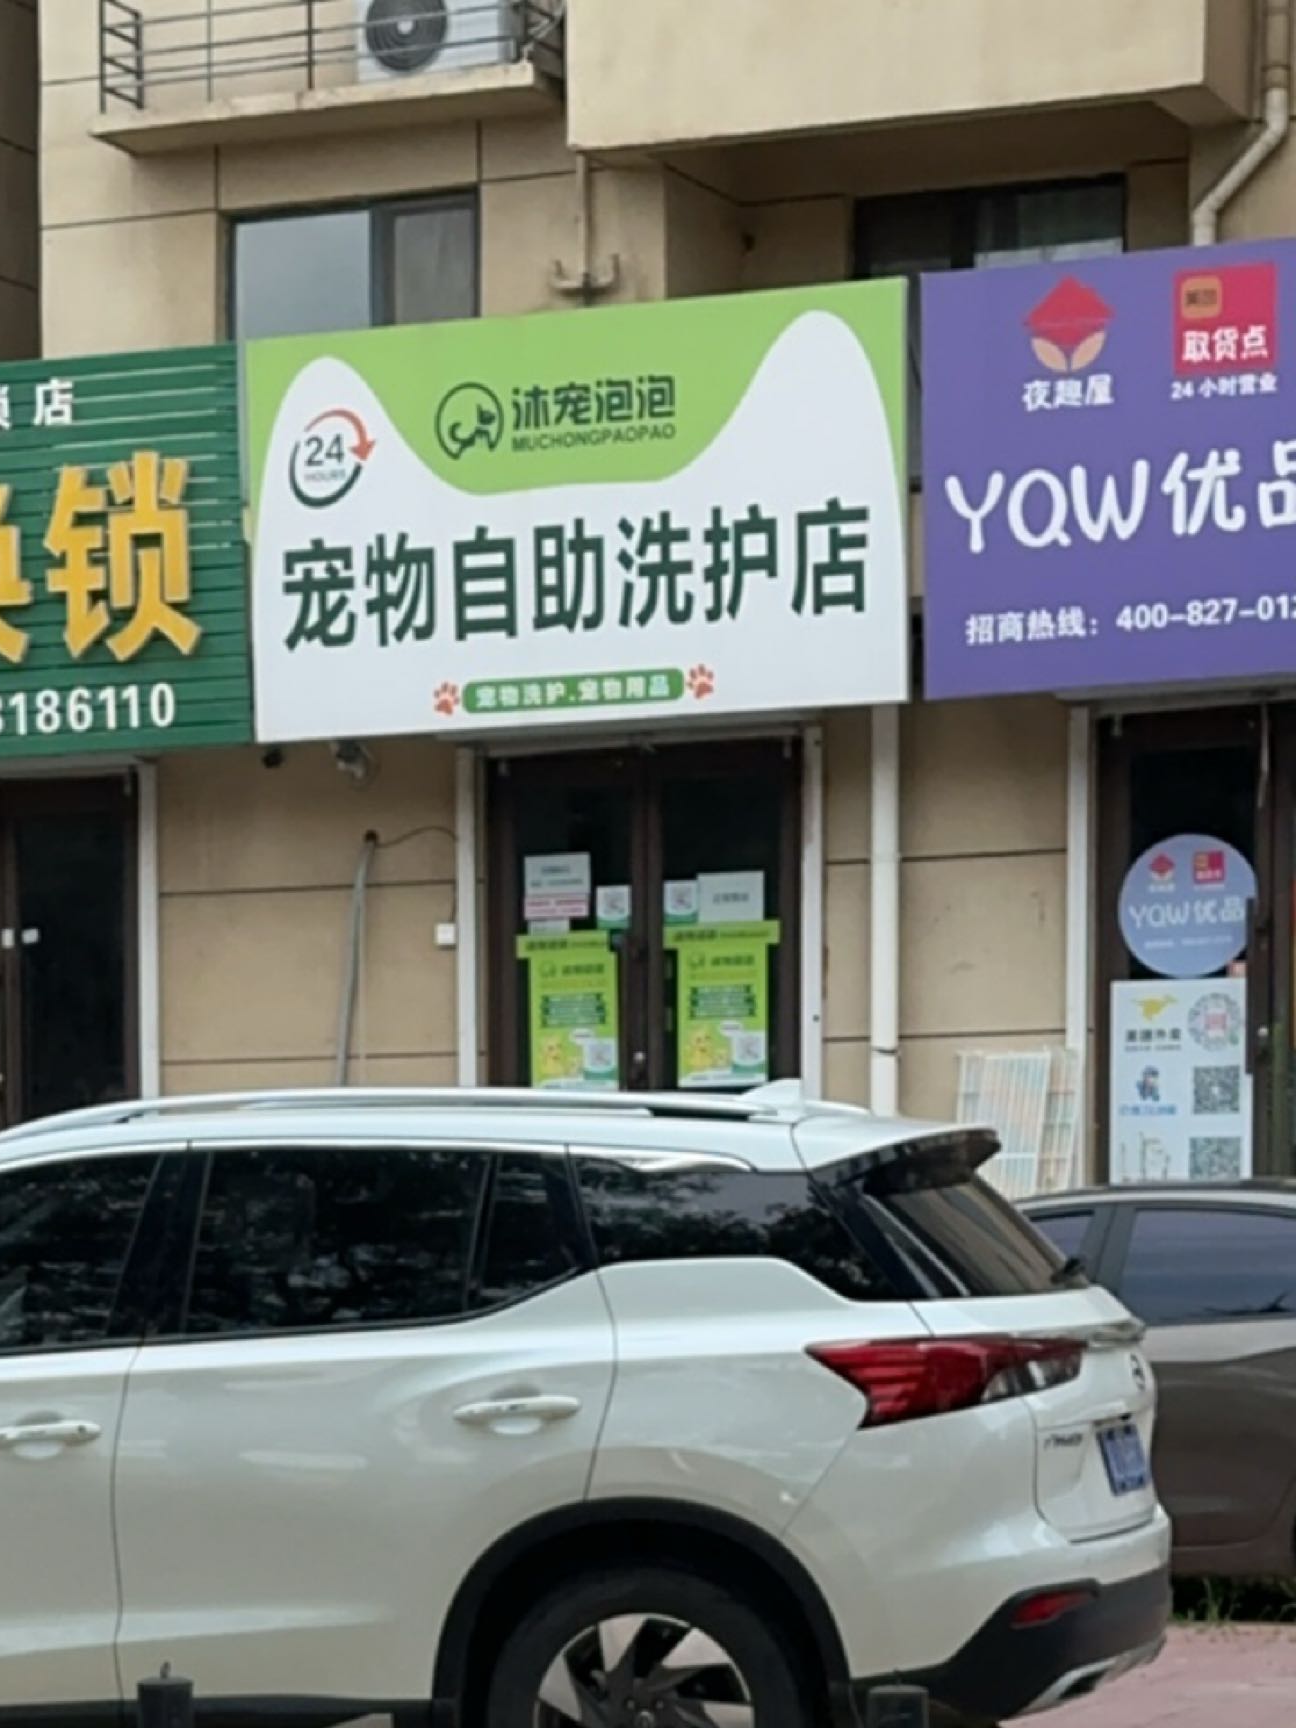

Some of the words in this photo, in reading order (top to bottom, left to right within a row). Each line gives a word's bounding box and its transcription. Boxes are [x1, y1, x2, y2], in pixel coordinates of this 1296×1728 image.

[1182, 324, 1268, 362] 取货点
[511, 375, 676, 431] 沐宠泡泡
[304, 433, 345, 467] 24
[511, 422, 676, 452] MUCHONGPAOPAO
[282, 498, 870, 652] 宠物自助洗护店
[1116, 594, 1296, 632] 400-827-01
